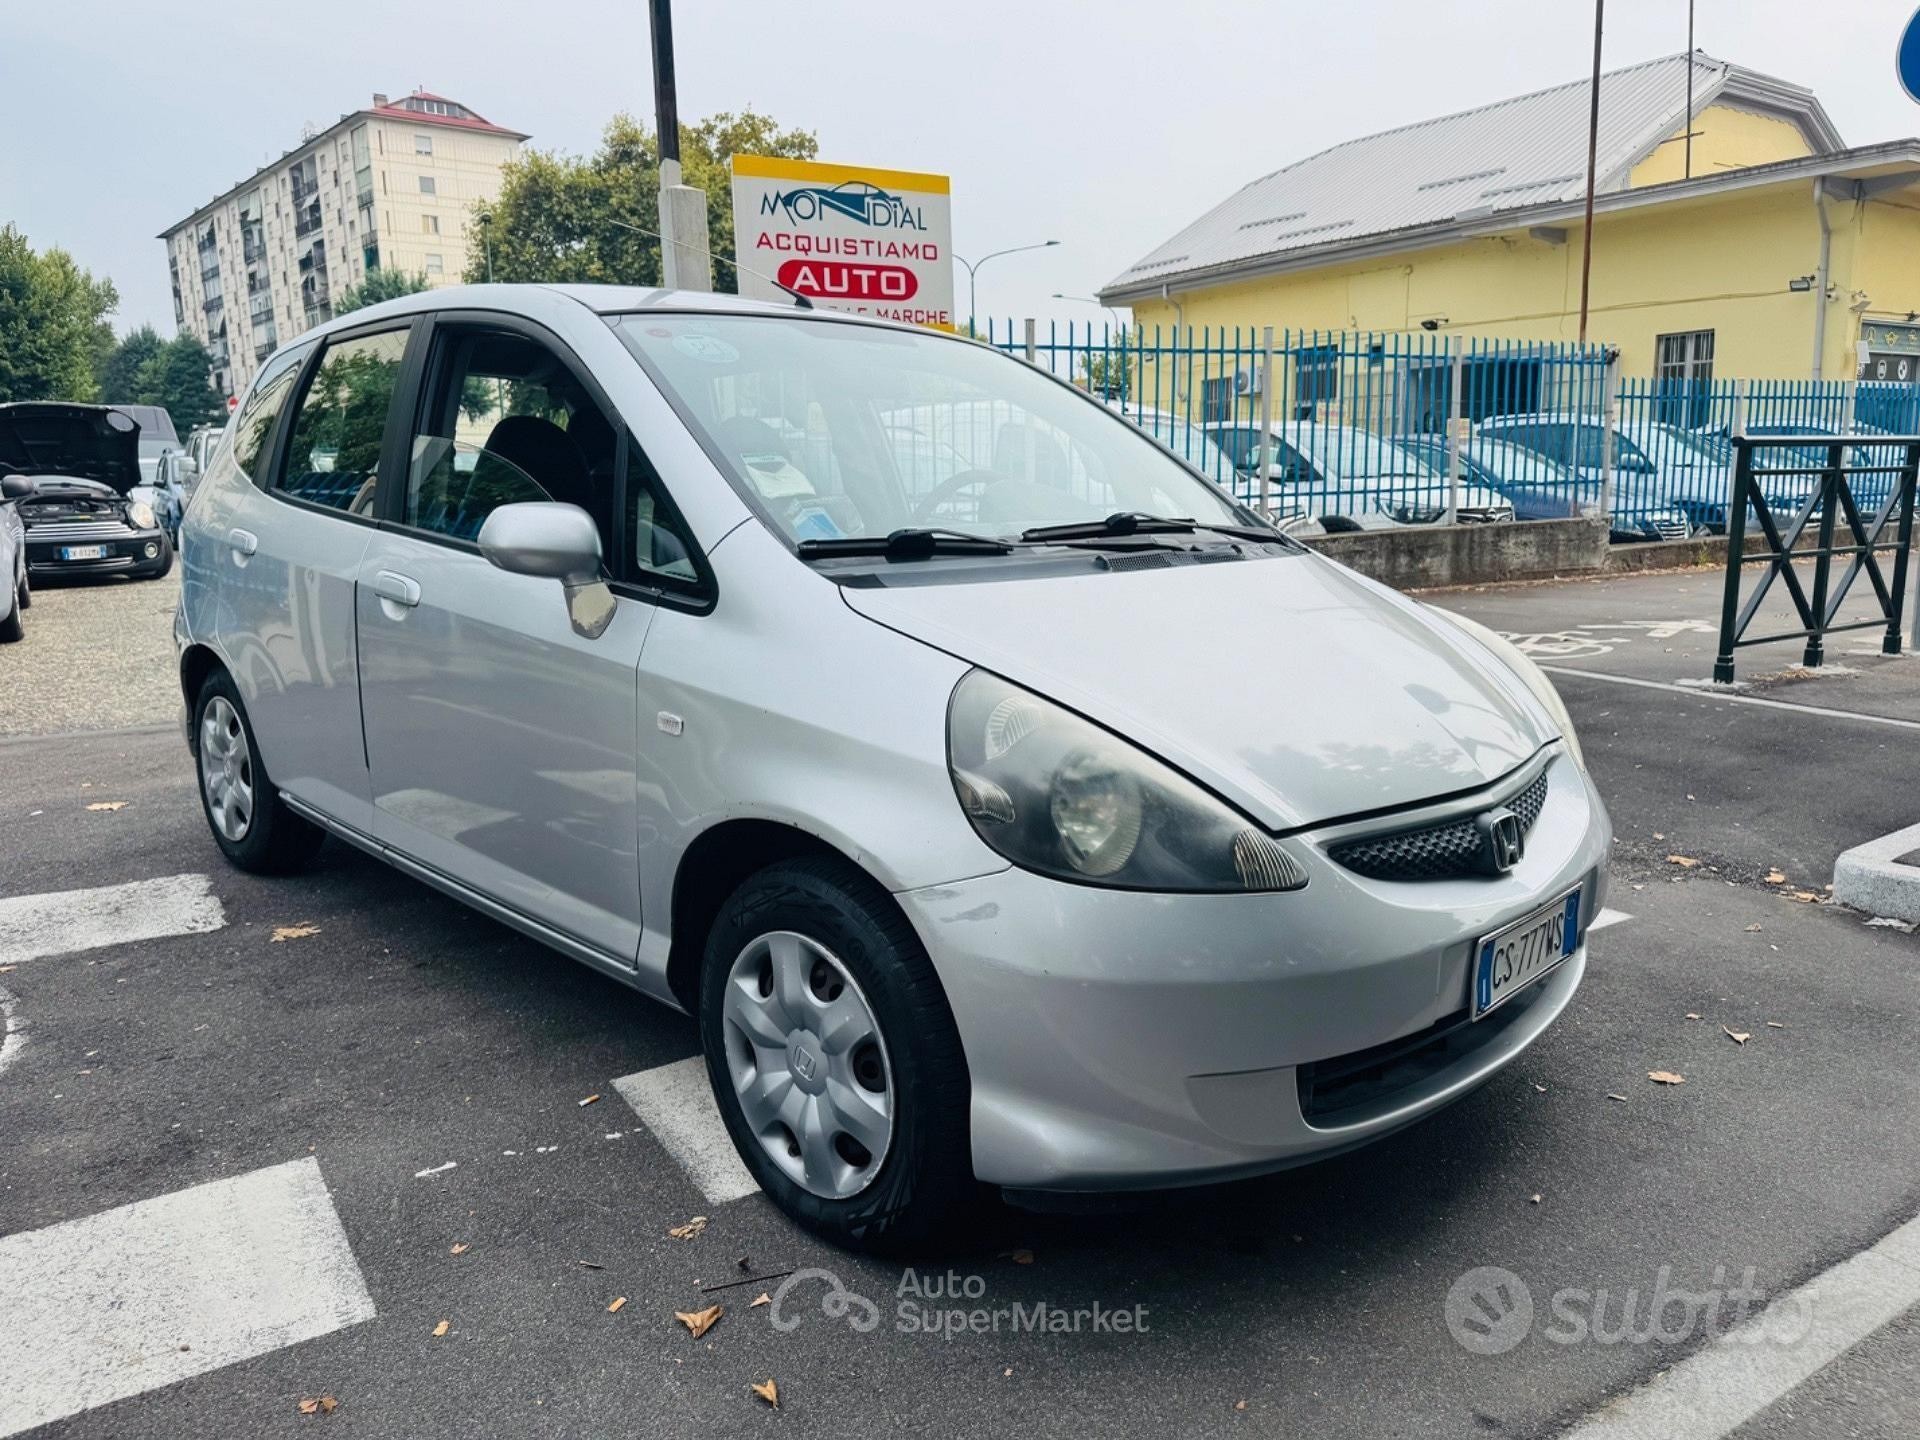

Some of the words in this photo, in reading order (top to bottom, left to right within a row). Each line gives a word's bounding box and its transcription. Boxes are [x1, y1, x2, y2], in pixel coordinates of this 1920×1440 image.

[756, 231, 938, 261] ACQUISTIAMO
[792, 265, 907, 296] AUTO
[876, 308, 949, 325] MARCHE
